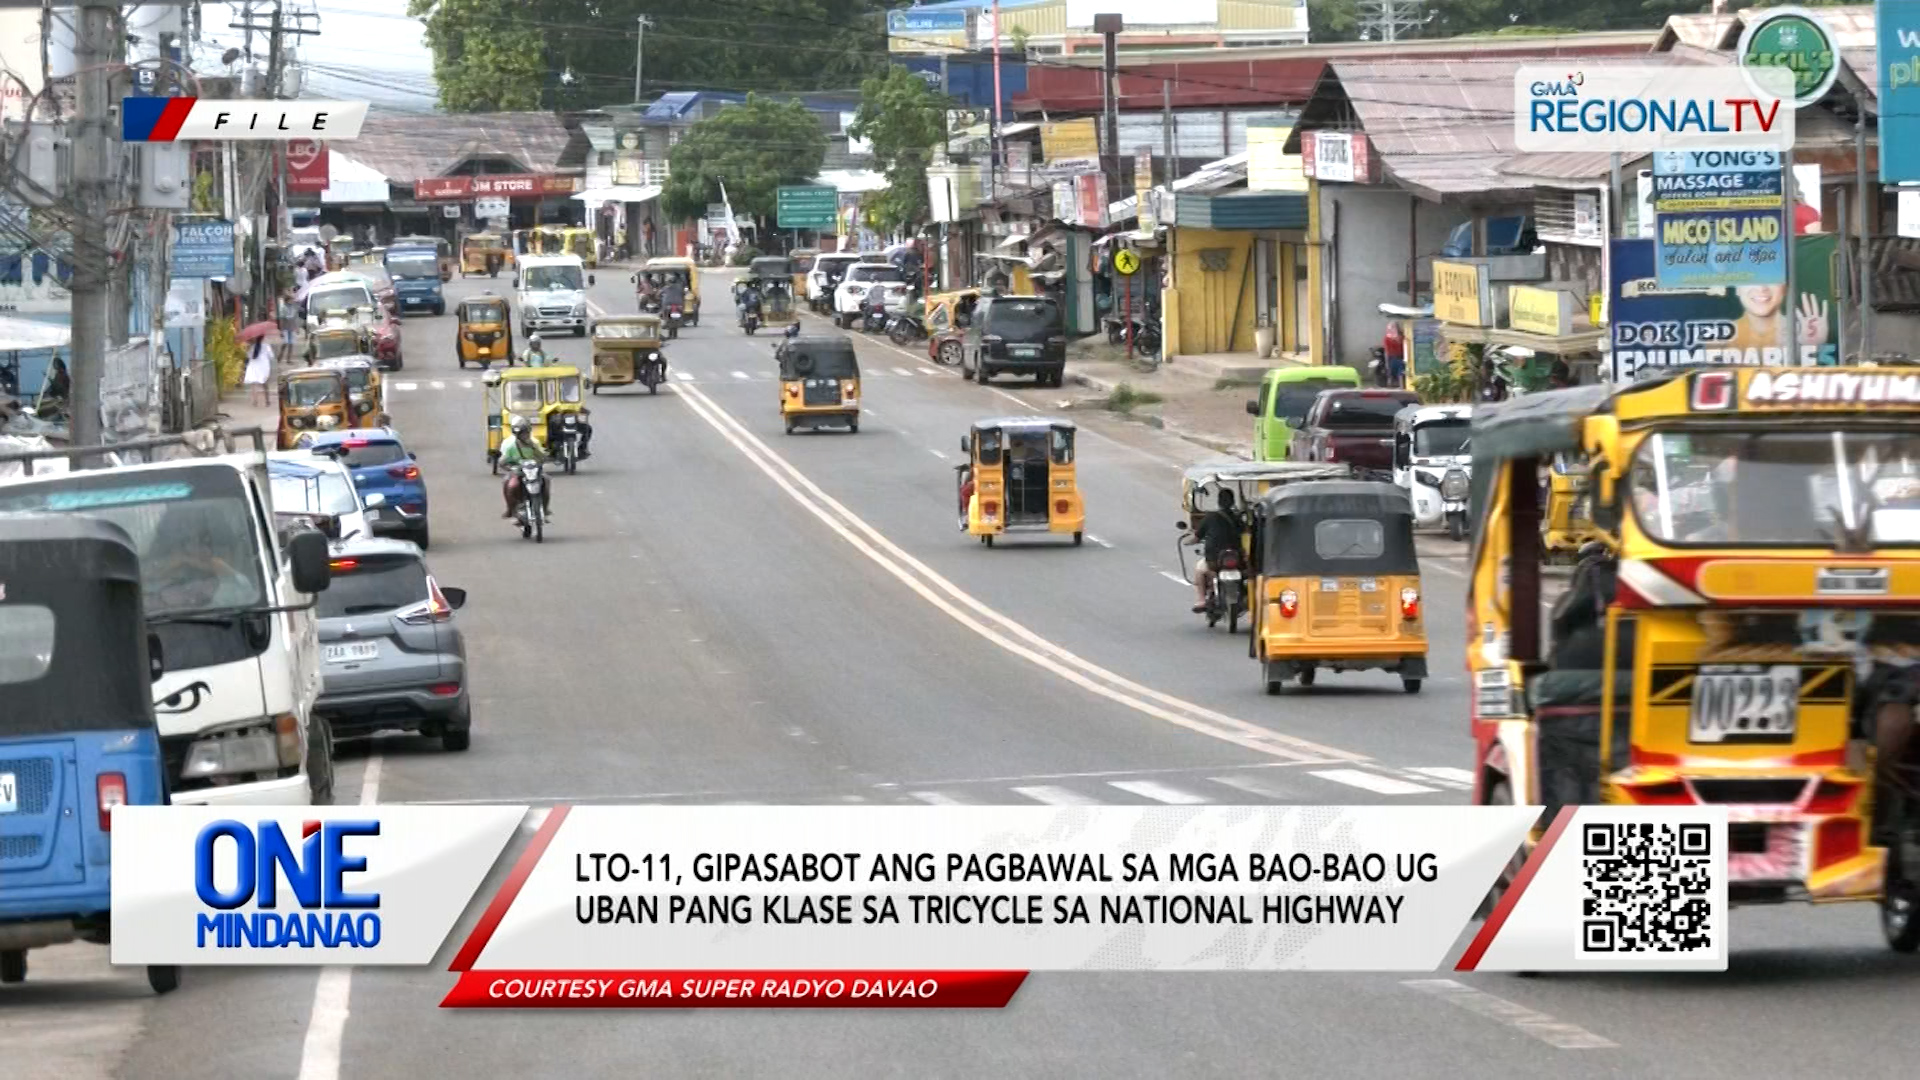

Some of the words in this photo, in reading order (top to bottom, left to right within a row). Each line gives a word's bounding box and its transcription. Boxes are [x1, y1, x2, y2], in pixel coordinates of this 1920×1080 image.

[1744, 51, 1835, 69] CECIL'S
[1690, 149, 1775, 168] YONG'S
[494, 179, 533, 192] STORE
[1656, 174, 1744, 190] MASSAGE
[181, 225, 233, 236] FALCON
[1663, 219, 1711, 245] MICO
[1715, 216, 1780, 243] ISLAND
[1617, 322, 1680, 346] DOK
[1684, 320, 1737, 346] JED
